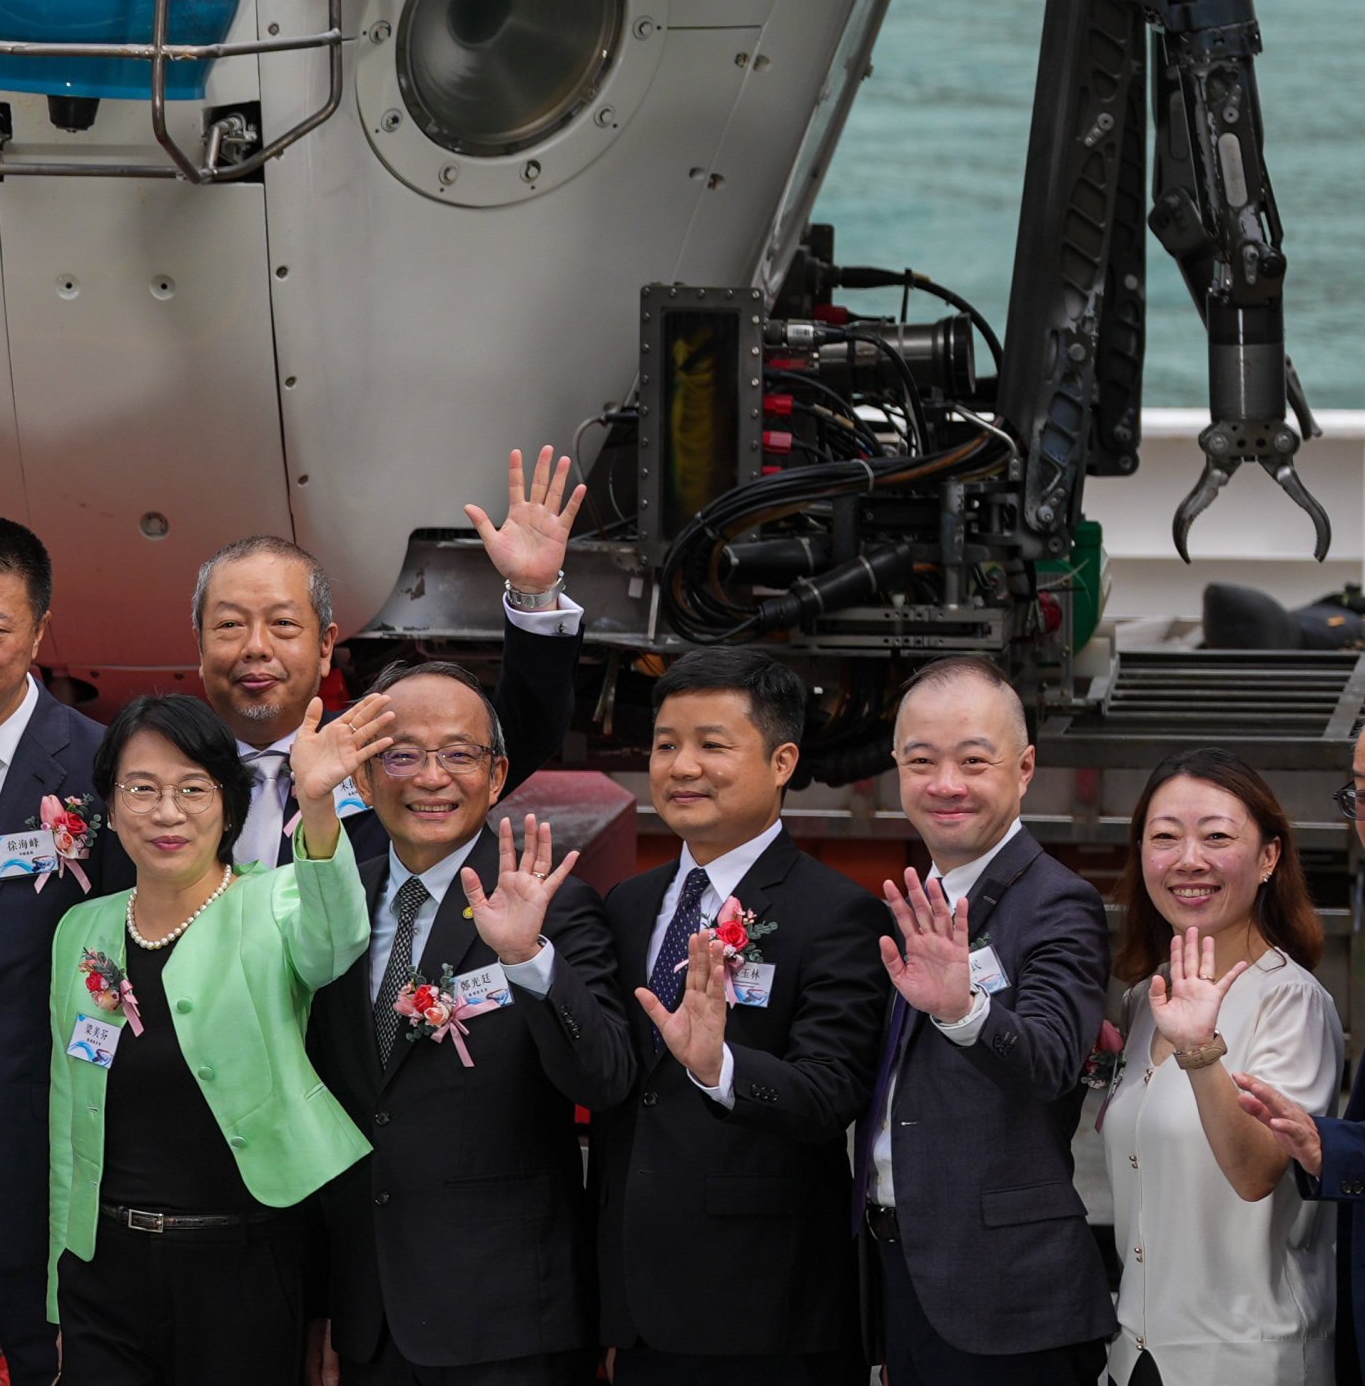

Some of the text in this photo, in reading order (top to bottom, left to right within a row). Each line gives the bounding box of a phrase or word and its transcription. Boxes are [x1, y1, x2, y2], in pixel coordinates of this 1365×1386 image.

[7, 837, 39, 851] 徐海峰
[85, 1023, 109, 1040] 梁美芬
